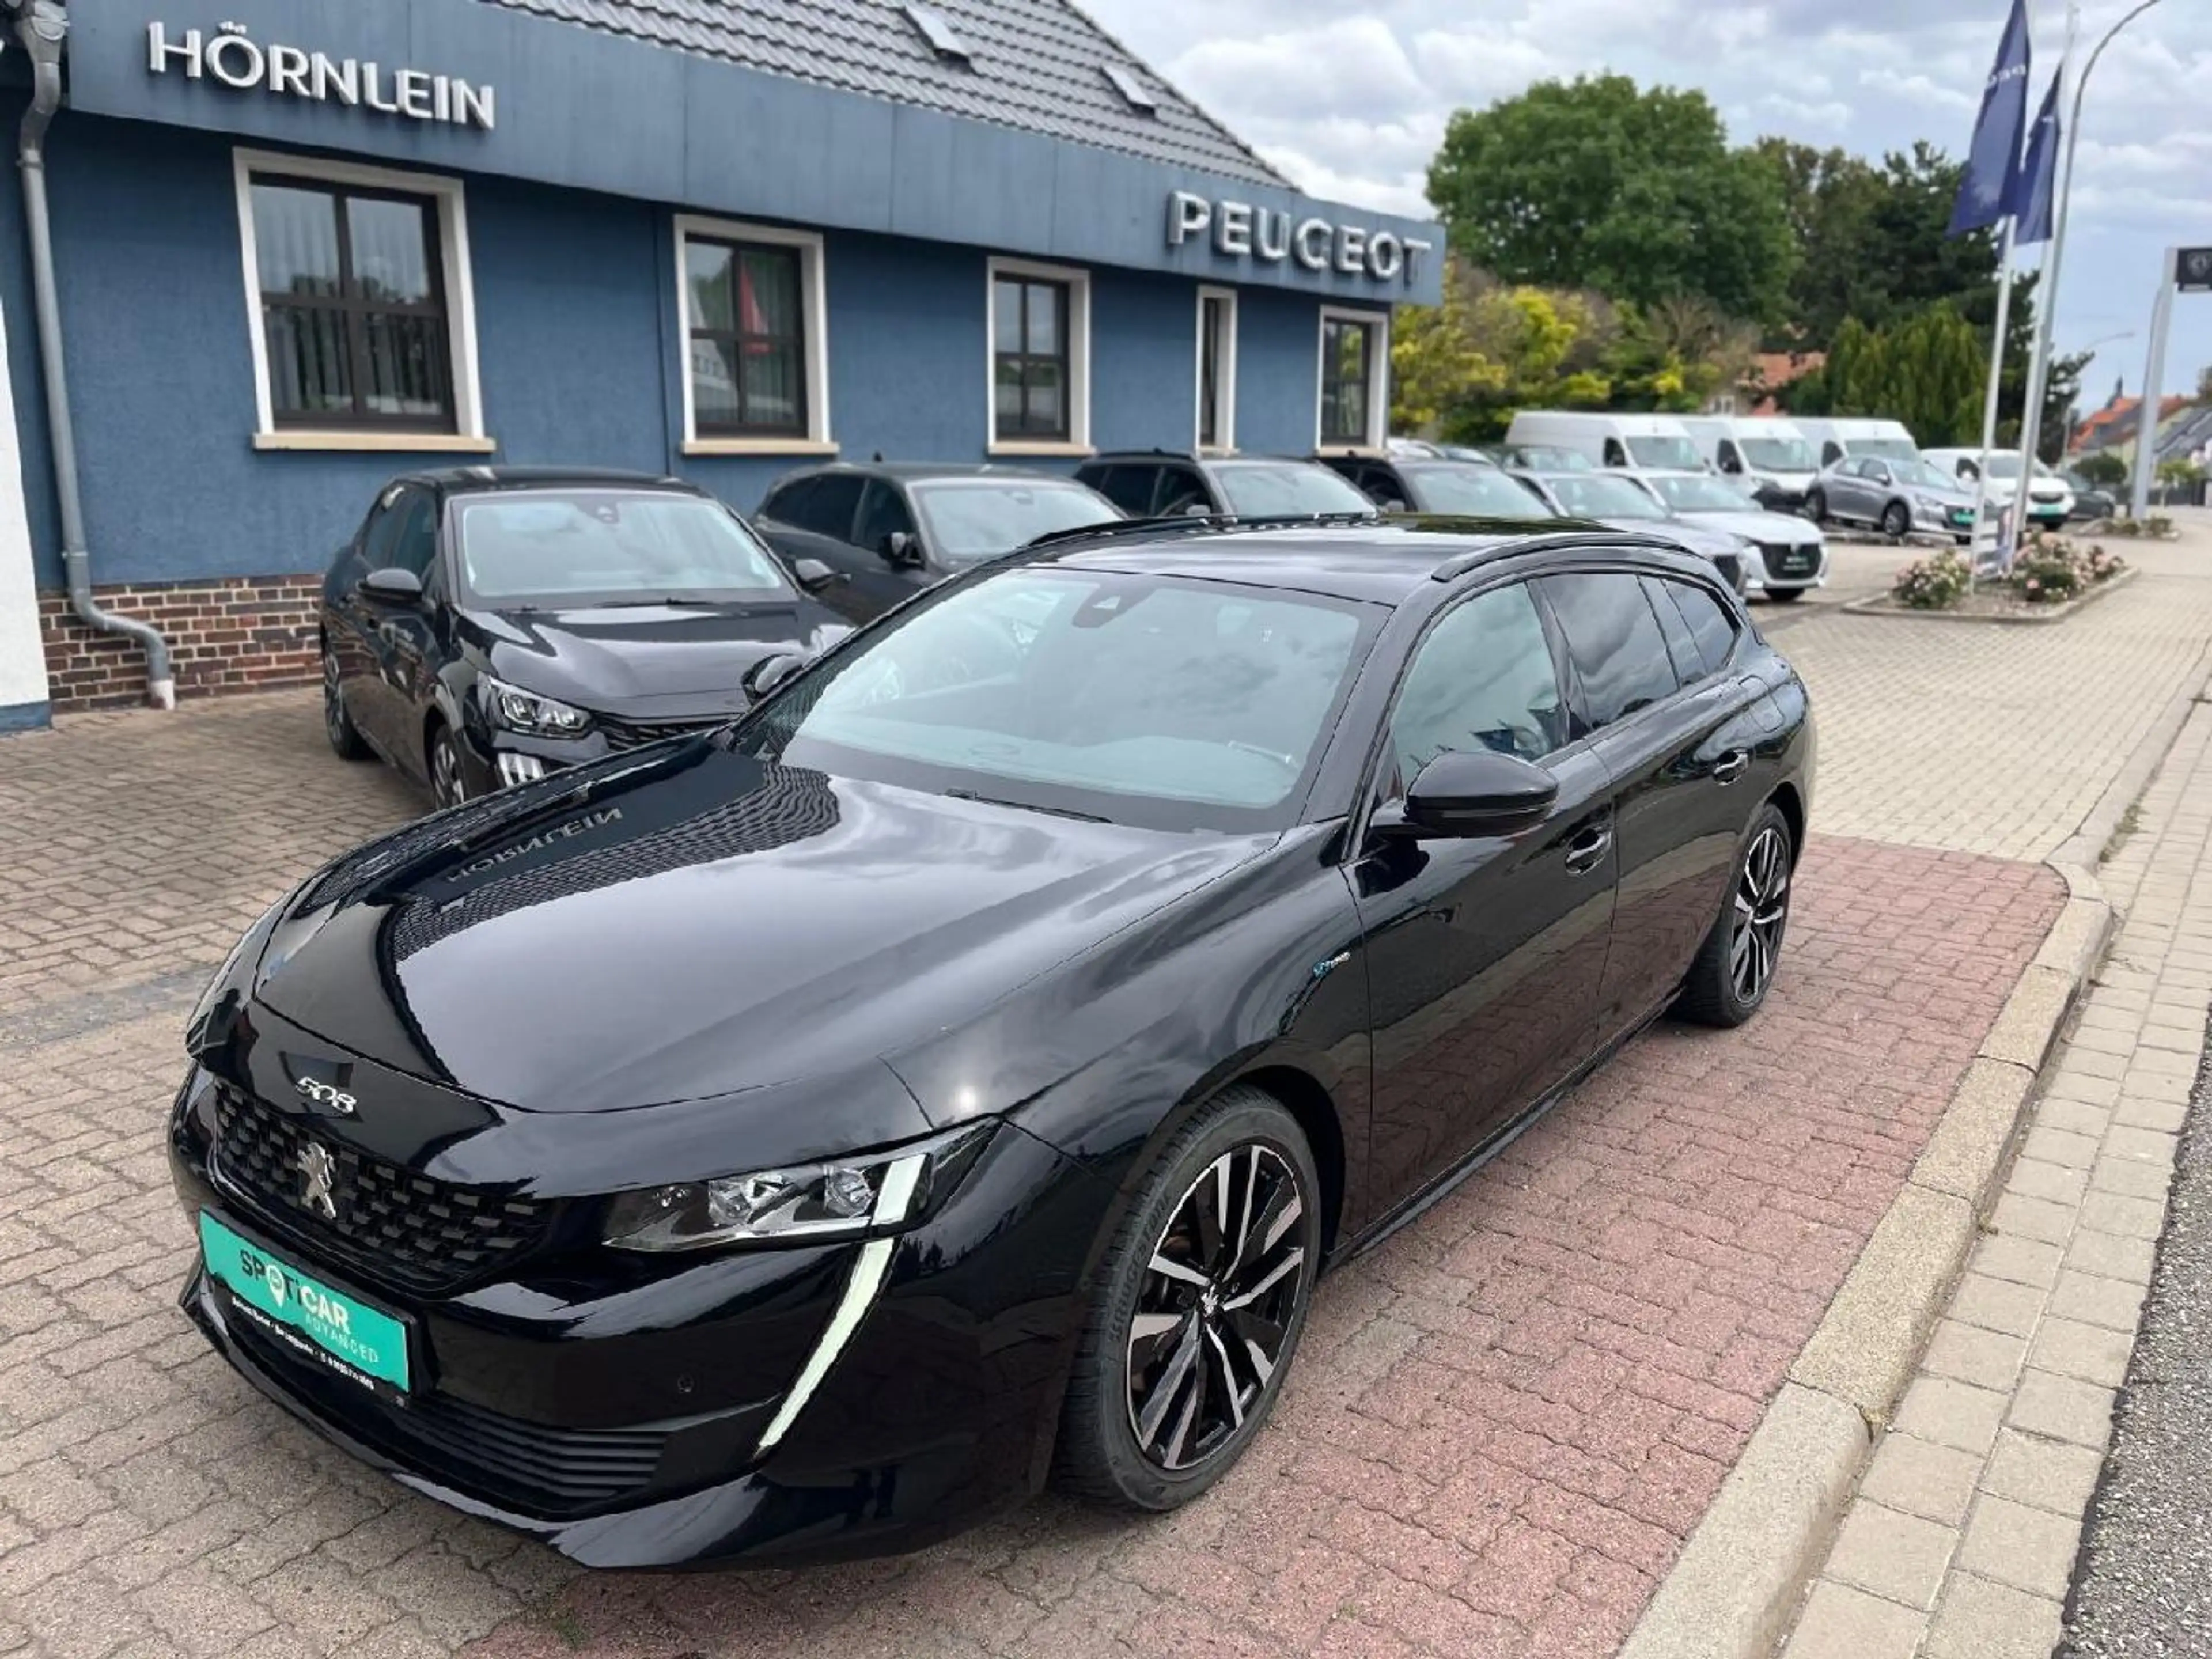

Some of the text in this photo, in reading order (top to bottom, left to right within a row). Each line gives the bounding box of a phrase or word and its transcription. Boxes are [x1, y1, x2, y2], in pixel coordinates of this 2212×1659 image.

[148, 21, 495, 130] HÖRNLEIN
[1167, 189, 1433, 288] PEUGEOT
[295, 1075, 357, 1115] 508
